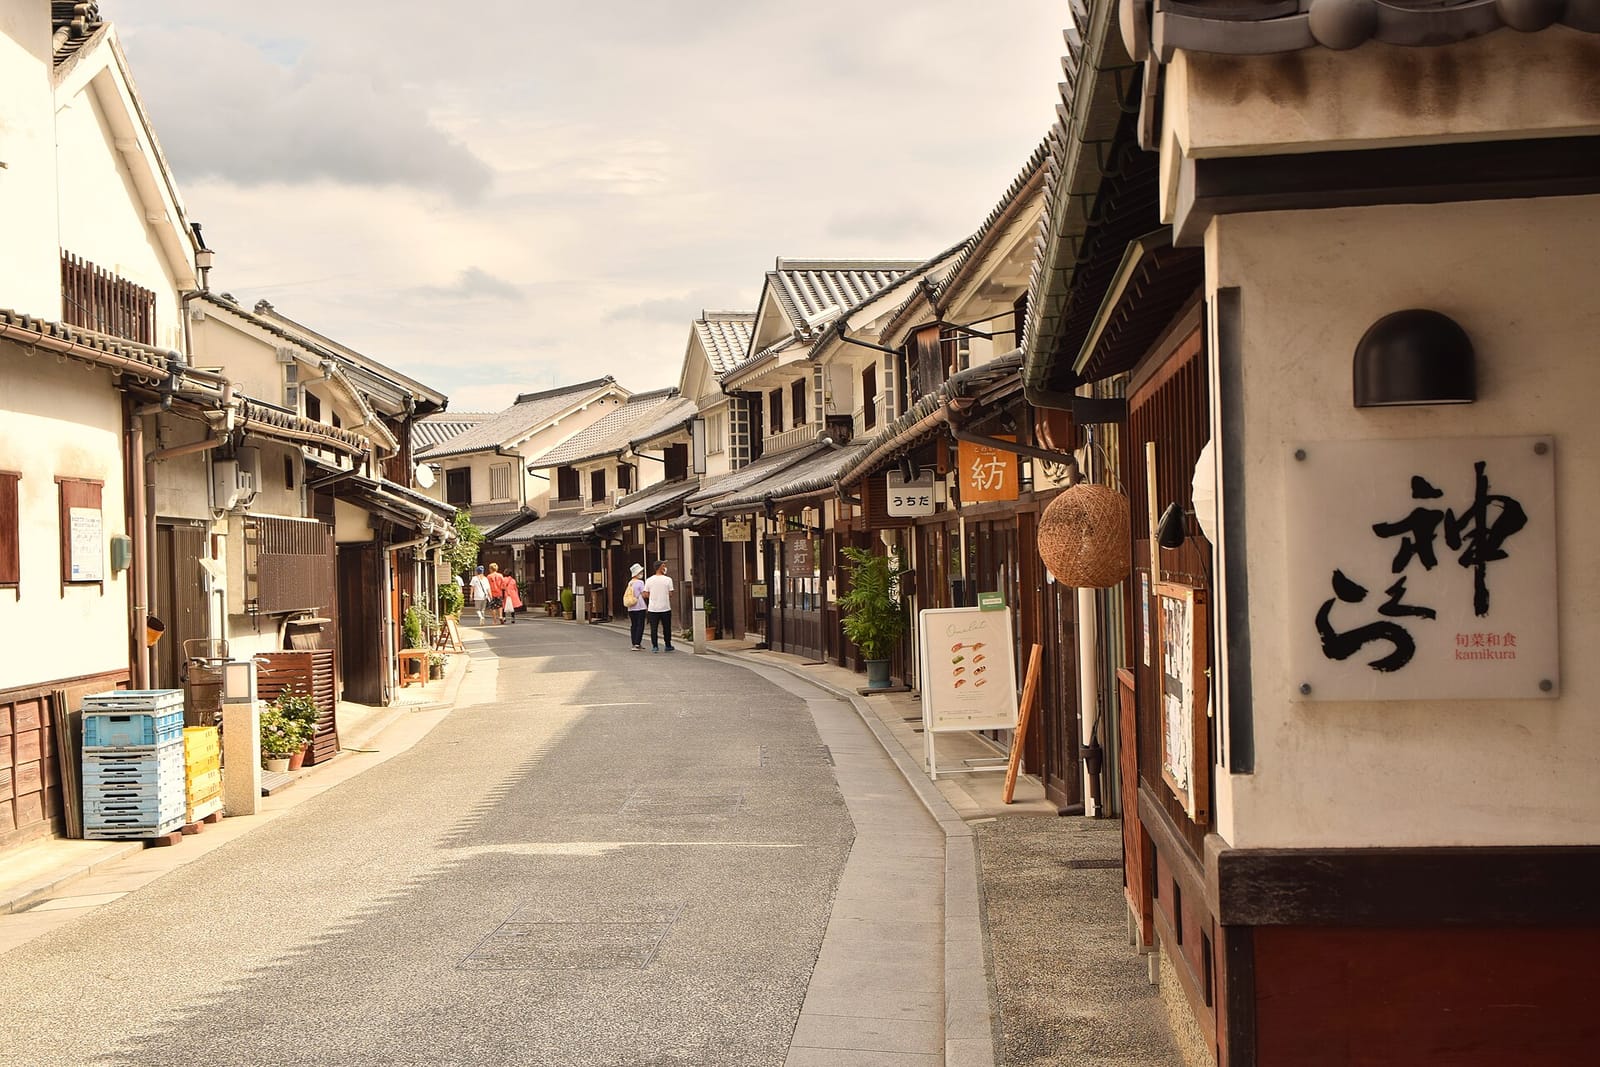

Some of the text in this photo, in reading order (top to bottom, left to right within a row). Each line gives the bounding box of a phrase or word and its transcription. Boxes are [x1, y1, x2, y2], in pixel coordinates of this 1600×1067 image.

[971, 456, 1007, 491] 紡
[893, 495, 929, 507] うちだ
[793, 539, 808, 564] 提灯
[1455, 632, 1517, 647] 旬菜和食
[1455, 649, 1516, 660] kamikura
